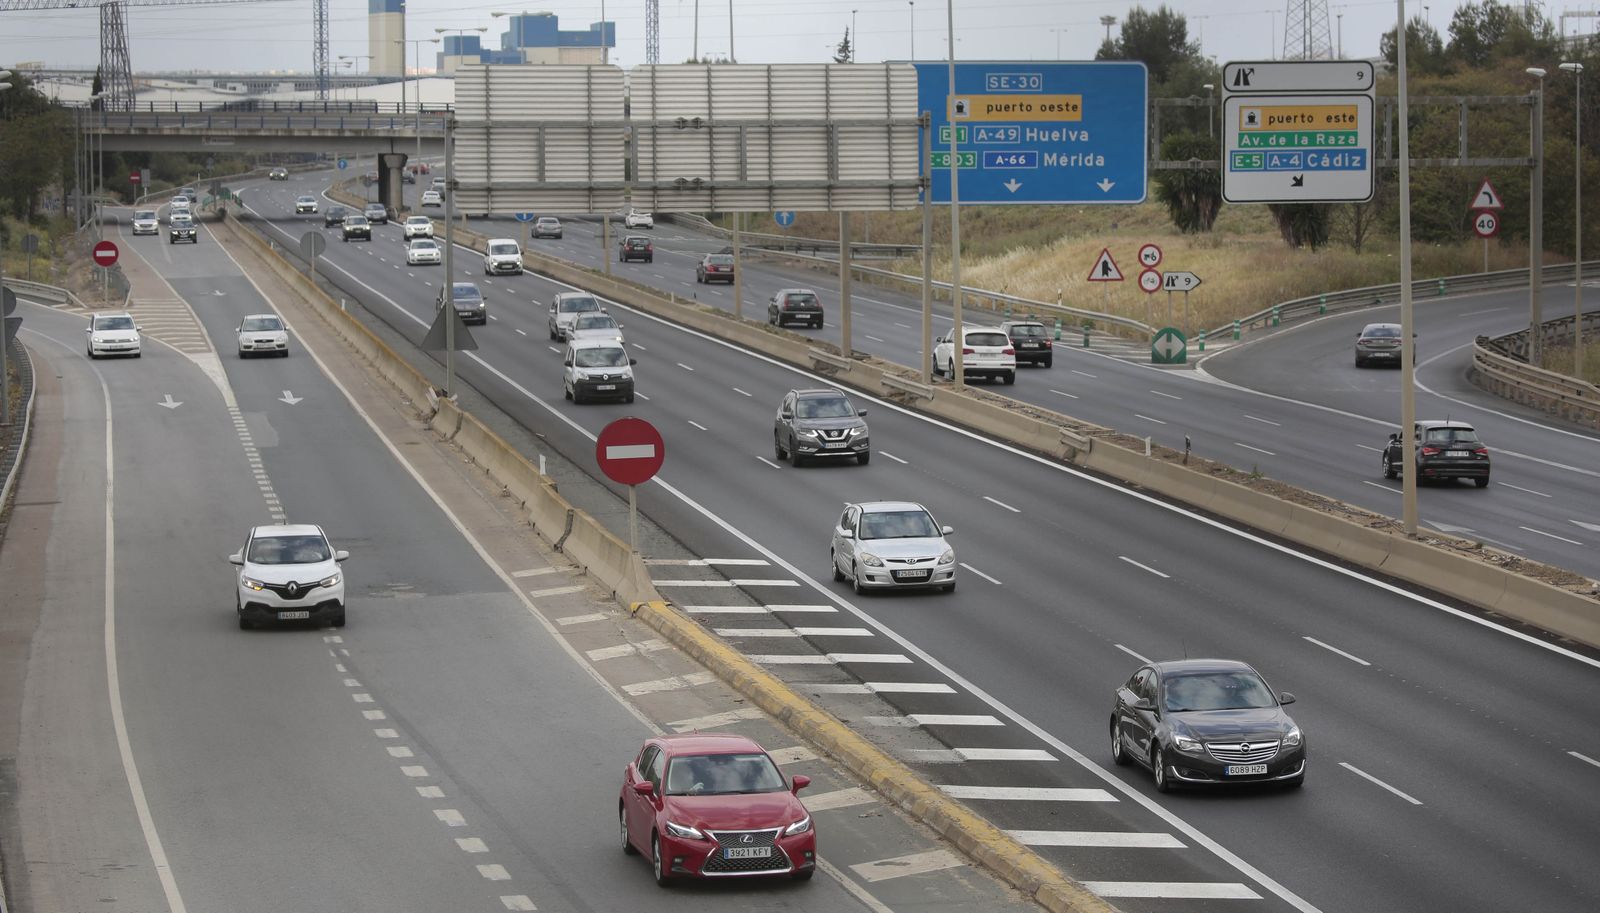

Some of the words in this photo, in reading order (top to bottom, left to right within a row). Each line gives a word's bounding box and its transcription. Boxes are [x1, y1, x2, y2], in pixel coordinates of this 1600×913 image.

[1356, 71, 1364, 80] 9
[989, 76, 1040, 89] SE-30
[986, 102, 1033, 115] puerto
[1040, 102, 1079, 112] oeste
[1268, 114, 1314, 126] puerto
[1326, 113, 1355, 123] este
[942, 129, 966, 141] E1
[977, 128, 1018, 141] A-49
[1025, 127, 1089, 142] Huelva
[1240, 134, 1264, 146] Av.
[1269, 134, 1287, 145] de
[1294, 134, 1308, 145] la
[1316, 133, 1356, 145] Raza
[995, 155, 1026, 165] A-66
[1043, 152, 1105, 167] Mérida
[1234, 155, 1261, 167] E-5
[1270, 155, 1300, 167] A-4
[1307, 153, 1361, 167] Cádiz
[1478, 219, 1495, 229] 40
[1184, 277, 1191, 286] 9
[1230, 766, 1250, 774] 6089
[1251, 765, 1266, 773] HZP
[730, 848, 751, 857] 3921
[752, 847, 769, 856] KFY
